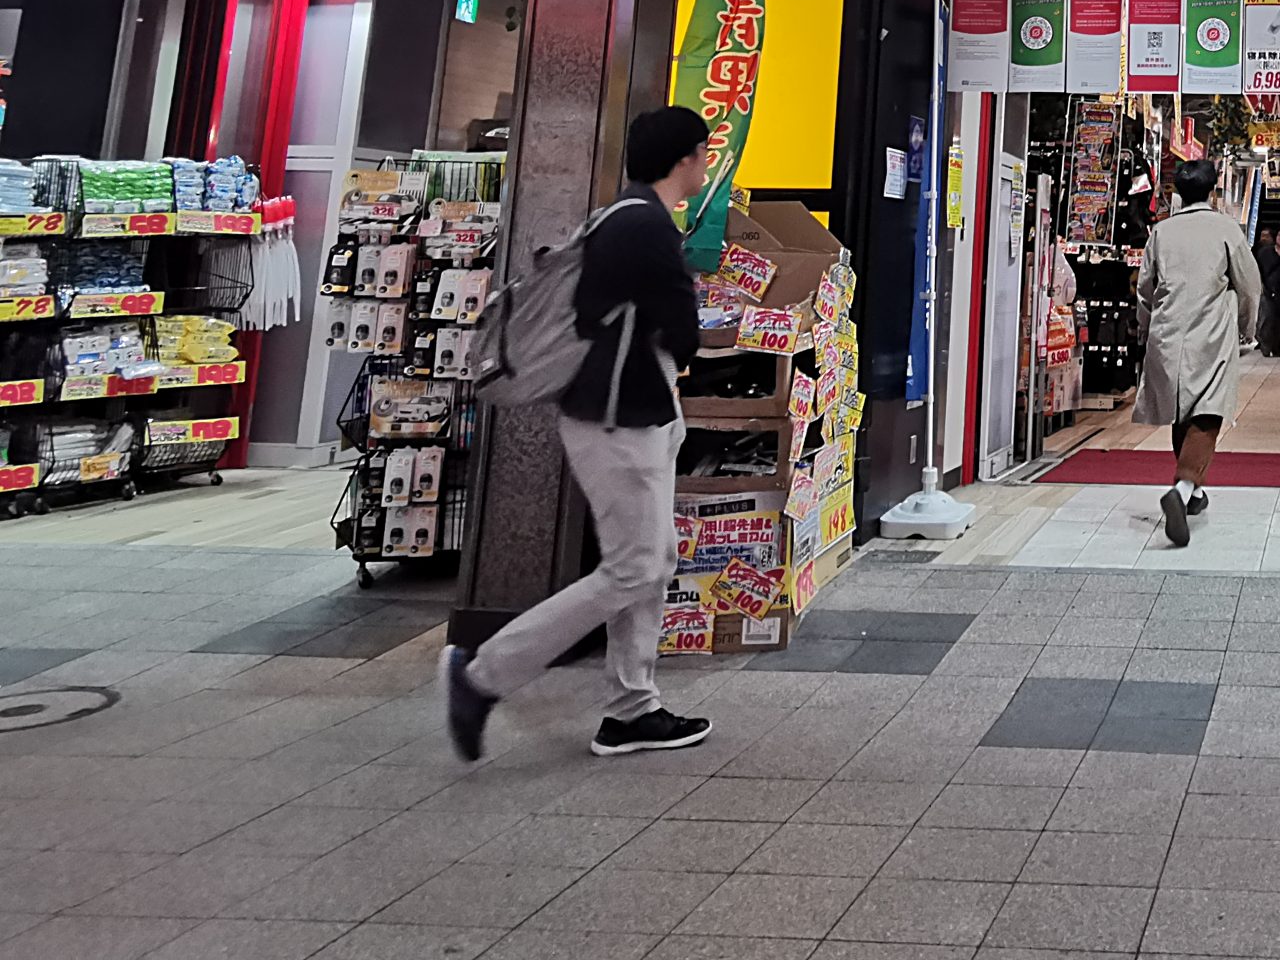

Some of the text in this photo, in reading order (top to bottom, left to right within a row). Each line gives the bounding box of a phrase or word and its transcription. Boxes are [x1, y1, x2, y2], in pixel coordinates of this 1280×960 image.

[738, 273, 762, 292] 100
[760, 332, 789, 349] 100
[733, 591, 763, 615] 100
[676, 633, 706, 649] 100
